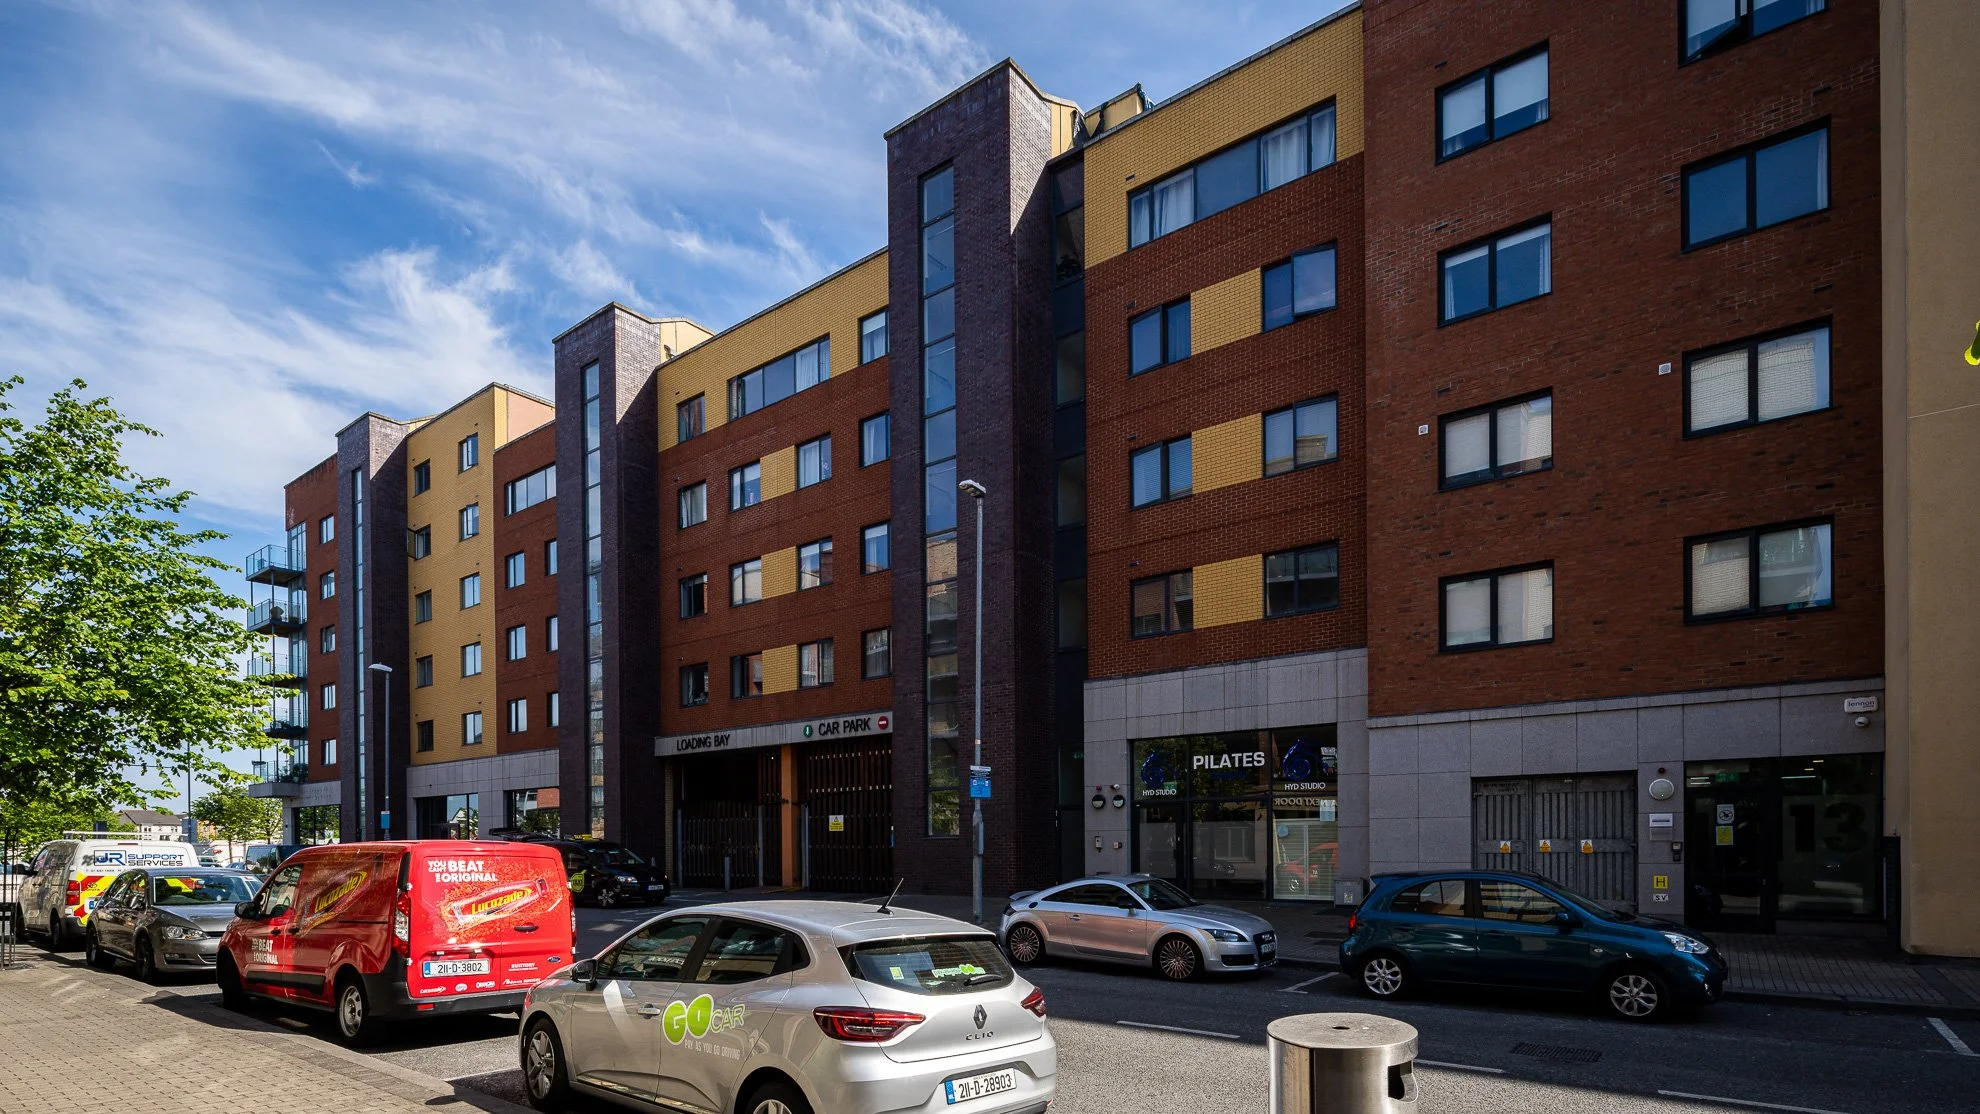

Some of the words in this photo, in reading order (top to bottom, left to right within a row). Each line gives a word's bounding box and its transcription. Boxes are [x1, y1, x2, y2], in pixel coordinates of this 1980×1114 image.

[818, 720, 840, 736] CAR
[842, 717, 871, 733] PARK
[676, 736, 712, 751] LOADING
[713, 734, 731, 748] BAY
[1193, 751, 1265, 770] PILATES
[1155, 788, 1177, 796] STUDIO
[1300, 782, 1326, 790] STUDIO
[1789, 802, 1868, 852] 13
[96, 852, 126, 866] JR
[427, 860, 447, 868] YOU
[447, 860, 485, 872] BEAT
[440, 872, 499, 883] ORIGINAL
[1656, 876, 1666, 887] H
[314, 875, 359, 913] Lucozade
[471, 890, 524, 914] Lucozade
[259, 939, 274, 952] BEAT
[438, 962, 482, 974] 211-D-3802
[965, 1031, 994, 1041] CLIO
[684, 1039, 694, 1050] PAY
[695, 1041, 702, 1052] AS
[703, 1042, 713, 1054] YOU
[713, 1044, 721, 1056] GO
[721, 1046, 740, 1061] DRIVING
[958, 1073, 1012, 1099] 211-D-28903
